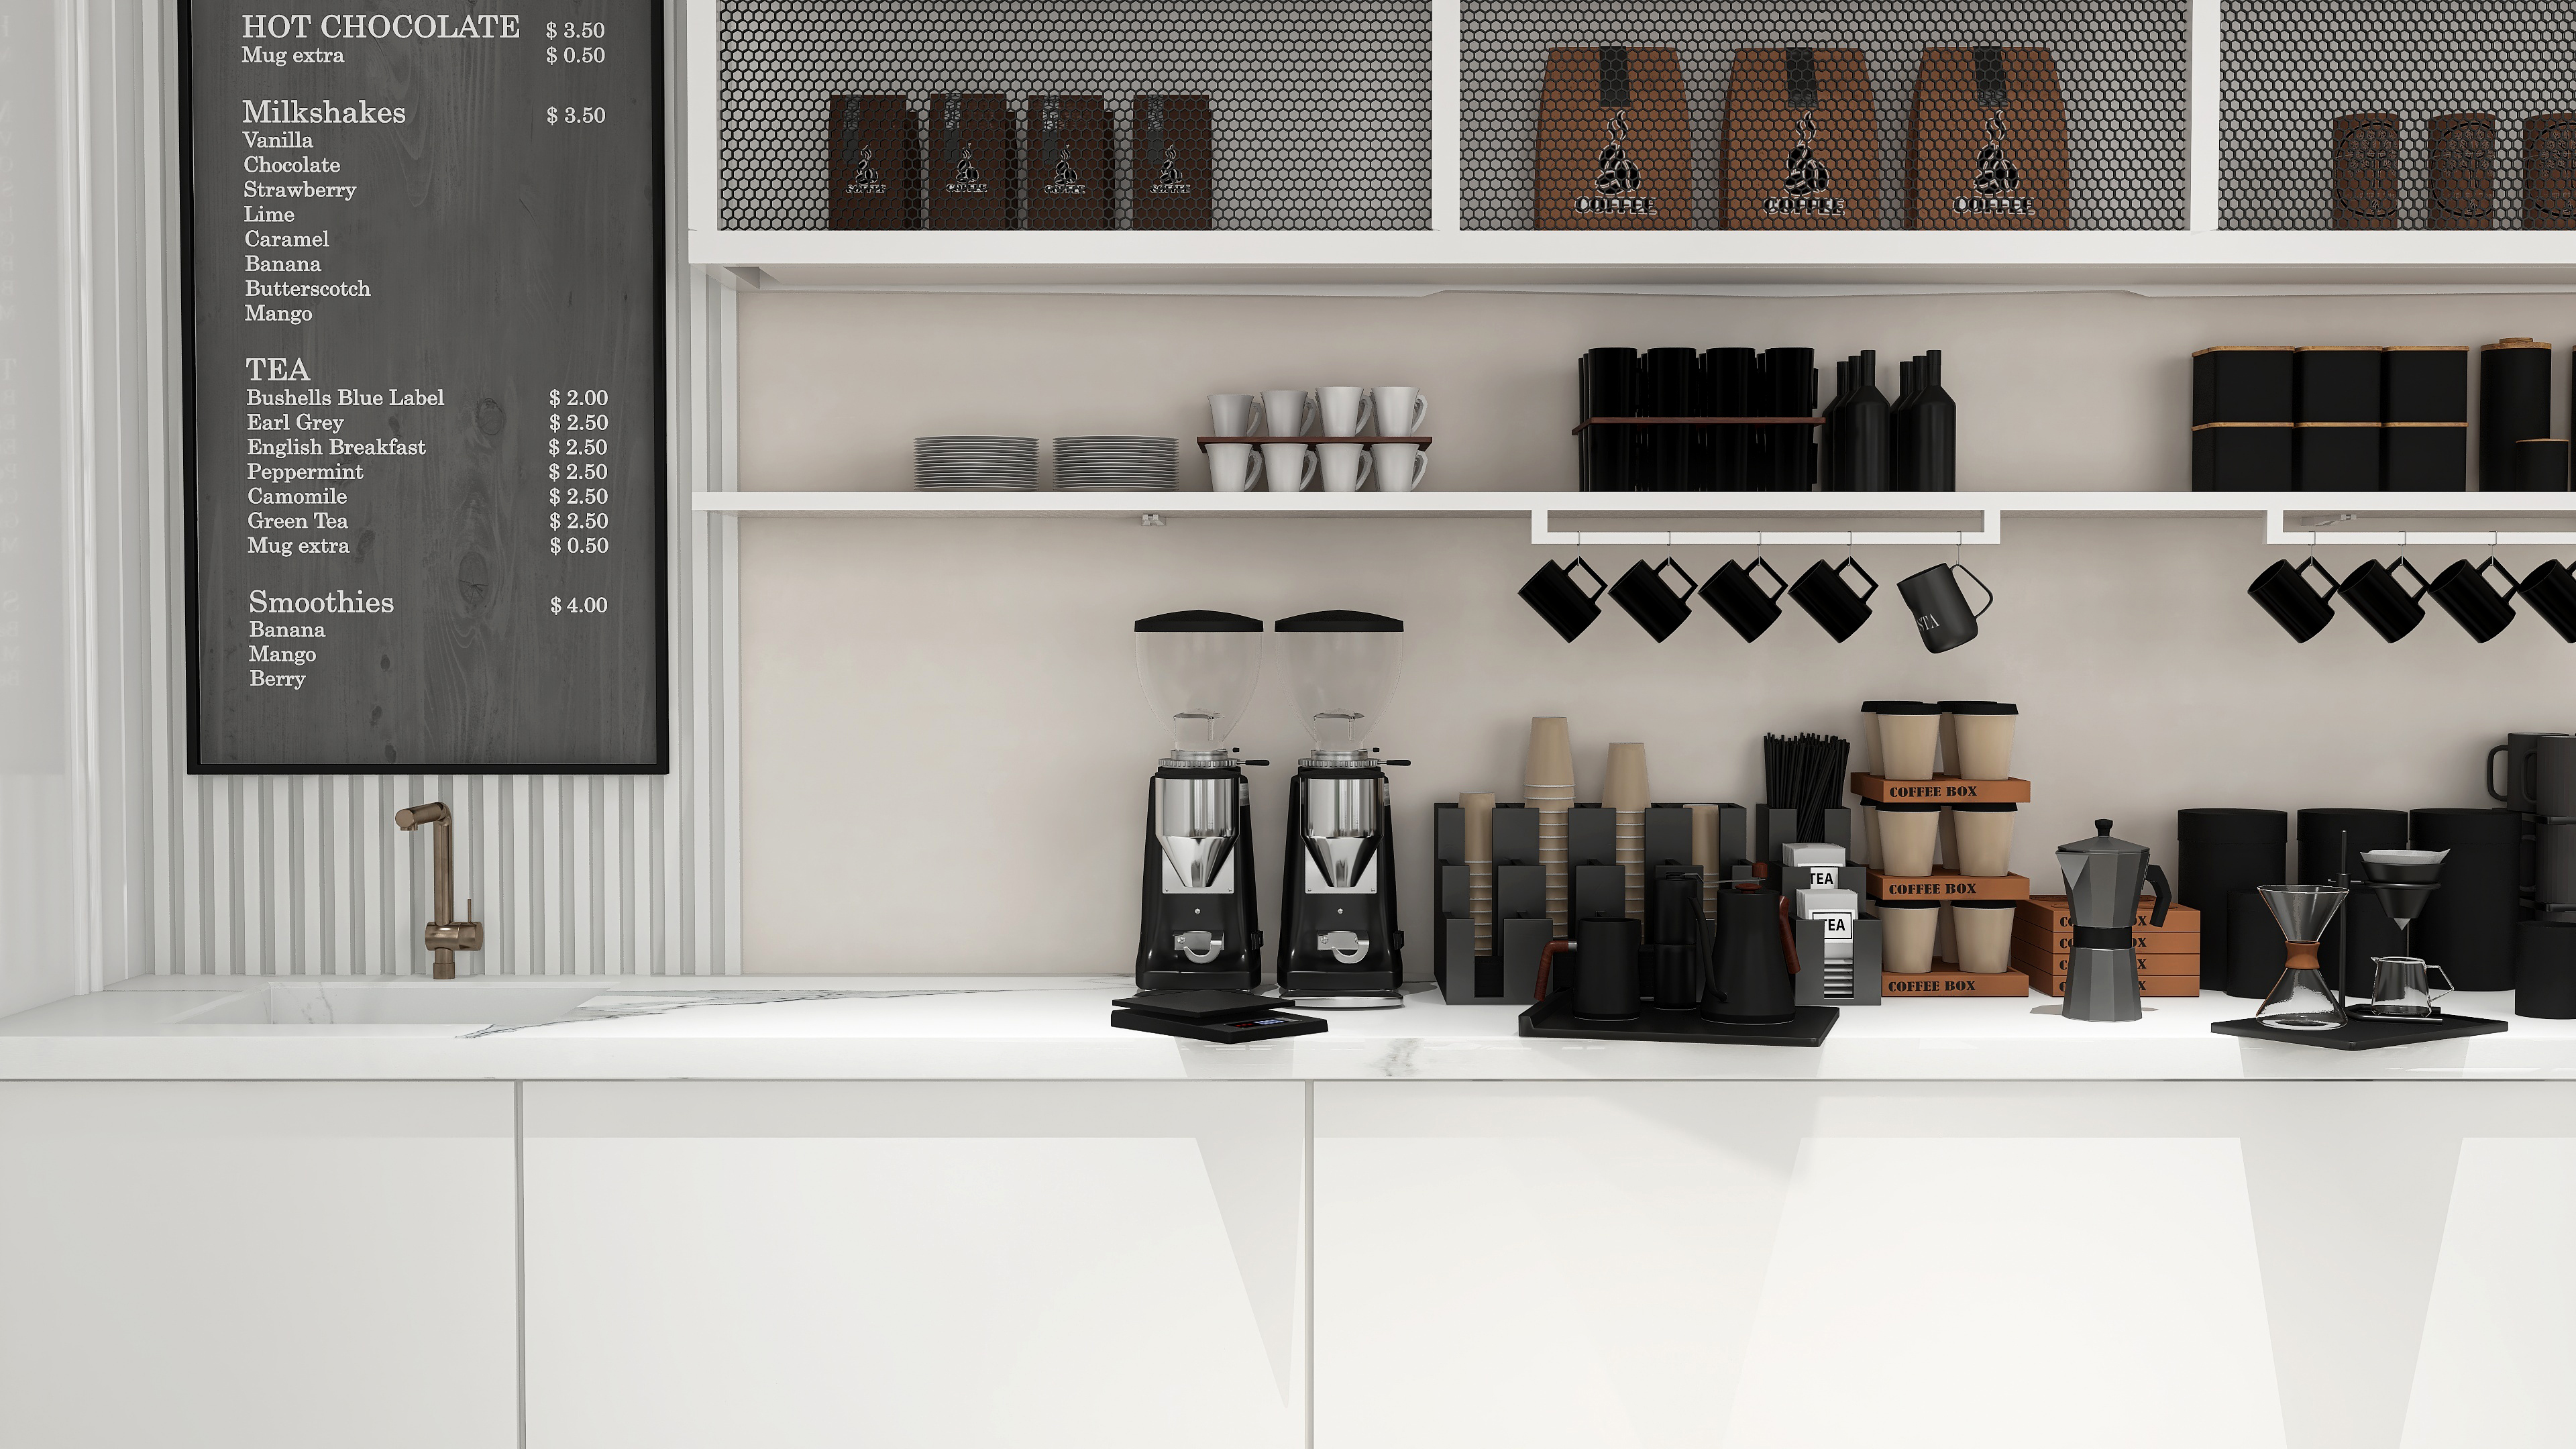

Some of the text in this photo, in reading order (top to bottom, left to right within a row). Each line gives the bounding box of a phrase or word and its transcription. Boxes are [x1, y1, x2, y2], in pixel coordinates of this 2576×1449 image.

[242, 15, 605, 40] HOT CHOCOLATE $ 3.50
[241, 46, 605, 66] Mug extra $ 0.50
[242, 100, 605, 125] Milkshakes $ 3.50
[242, 131, 313, 148] Vanilla
[244, 156, 340, 172] Chocolate
[244, 180, 357, 201] Strawberry
[244, 205, 294, 222] Lime
[246, 230, 329, 247] Caramel
[245, 255, 322, 272] Banana
[246, 280, 371, 296] Butterscotch
[245, 305, 312, 325] Mango
[246, 358, 311, 380] TEA
[247, 389, 608, 408] Bushells Blue Label $ 2.00
[247, 413, 608, 434] Earl Grey $ 2.50
[248, 438, 607, 458] English Breakfast $ 2.50
[247, 463, 607, 483] Peppermint $ 2.50
[248, 487, 608, 506] Camomile $ 2.50
[248, 512, 608, 531] Green Tea $ 2.50
[248, 537, 608, 557] Mug extra $ 0.50
[250, 590, 608, 615] Smoothies $ 4.00
[250, 621, 326, 637] Banana
[249, 645, 316, 665] Mango
[250, 670, 306, 690] Berry
[1890, 786, 1977, 797] COFFEE BOX
[1889, 883, 1976, 895] COFFEE BOX
[1888, 980, 1976, 991] COFFEE BOX
